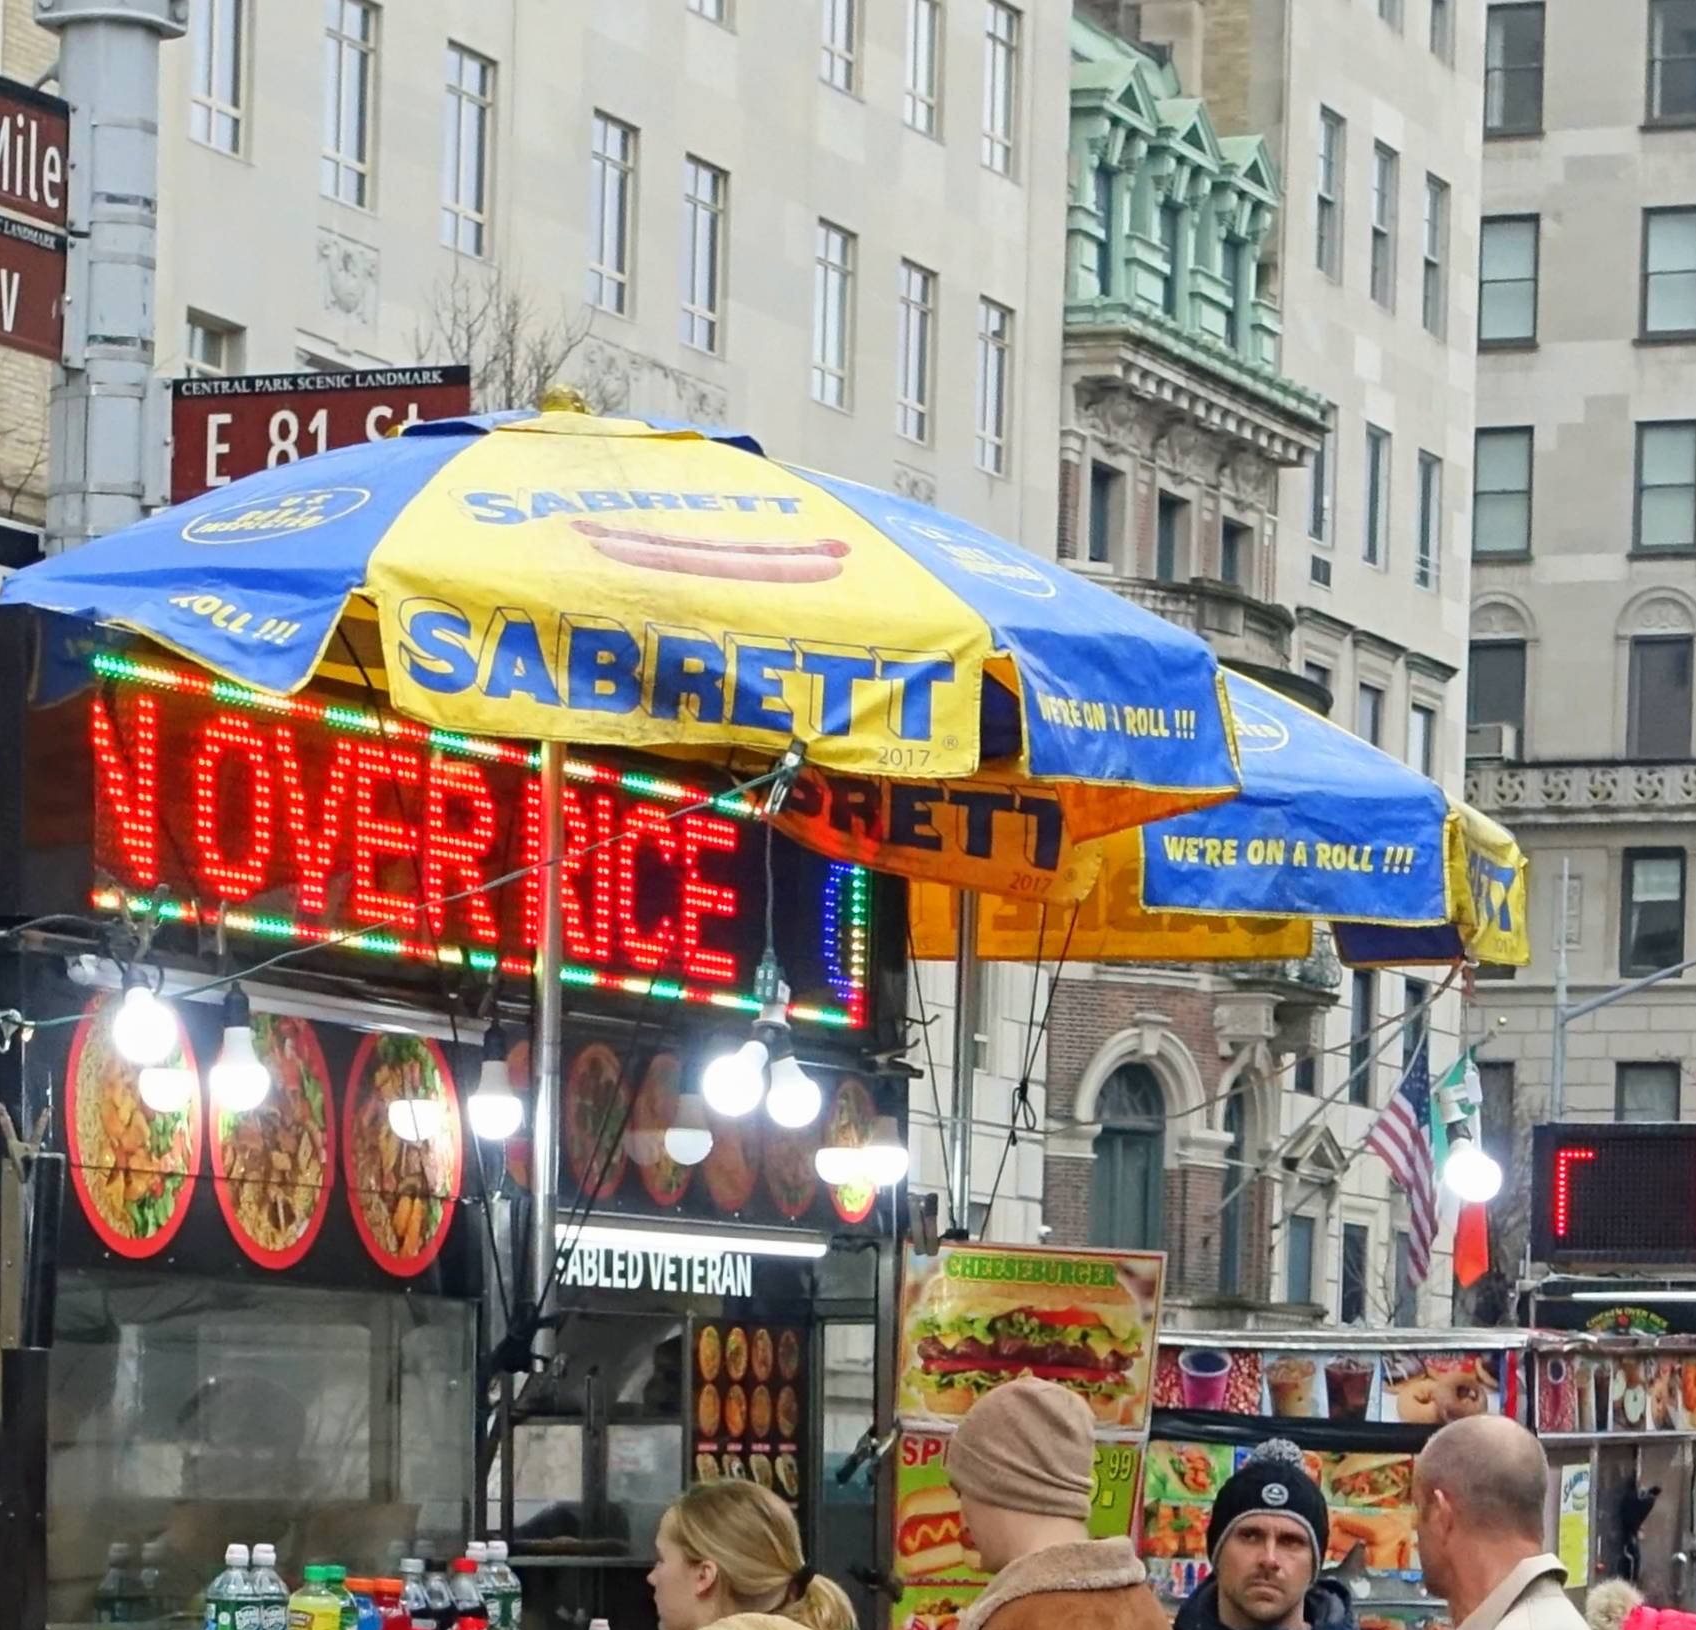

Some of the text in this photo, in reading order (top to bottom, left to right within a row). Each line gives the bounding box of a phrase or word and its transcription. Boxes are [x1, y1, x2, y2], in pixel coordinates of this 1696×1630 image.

[5, 220, 57, 250] LANDMARK
[181, 368, 444, 397] CENTRAL PARK SCENIC LANDMARK
[206, 413, 232, 488] E
[268, 408, 329, 471] 81
[452, 486, 801, 524] SABRETT
[399, 596, 956, 742] SABRETT
[877, 746, 931, 770] 2017
[194, 712, 500, 947] OVER
[523, 780, 740, 983] RICE
[1163, 834, 1414, 875] WE'RE ON A ROLL !!!
[646, 1251, 752, 1297] VETERAN
[946, 1253, 1118, 1288] CHEESEBURGER
